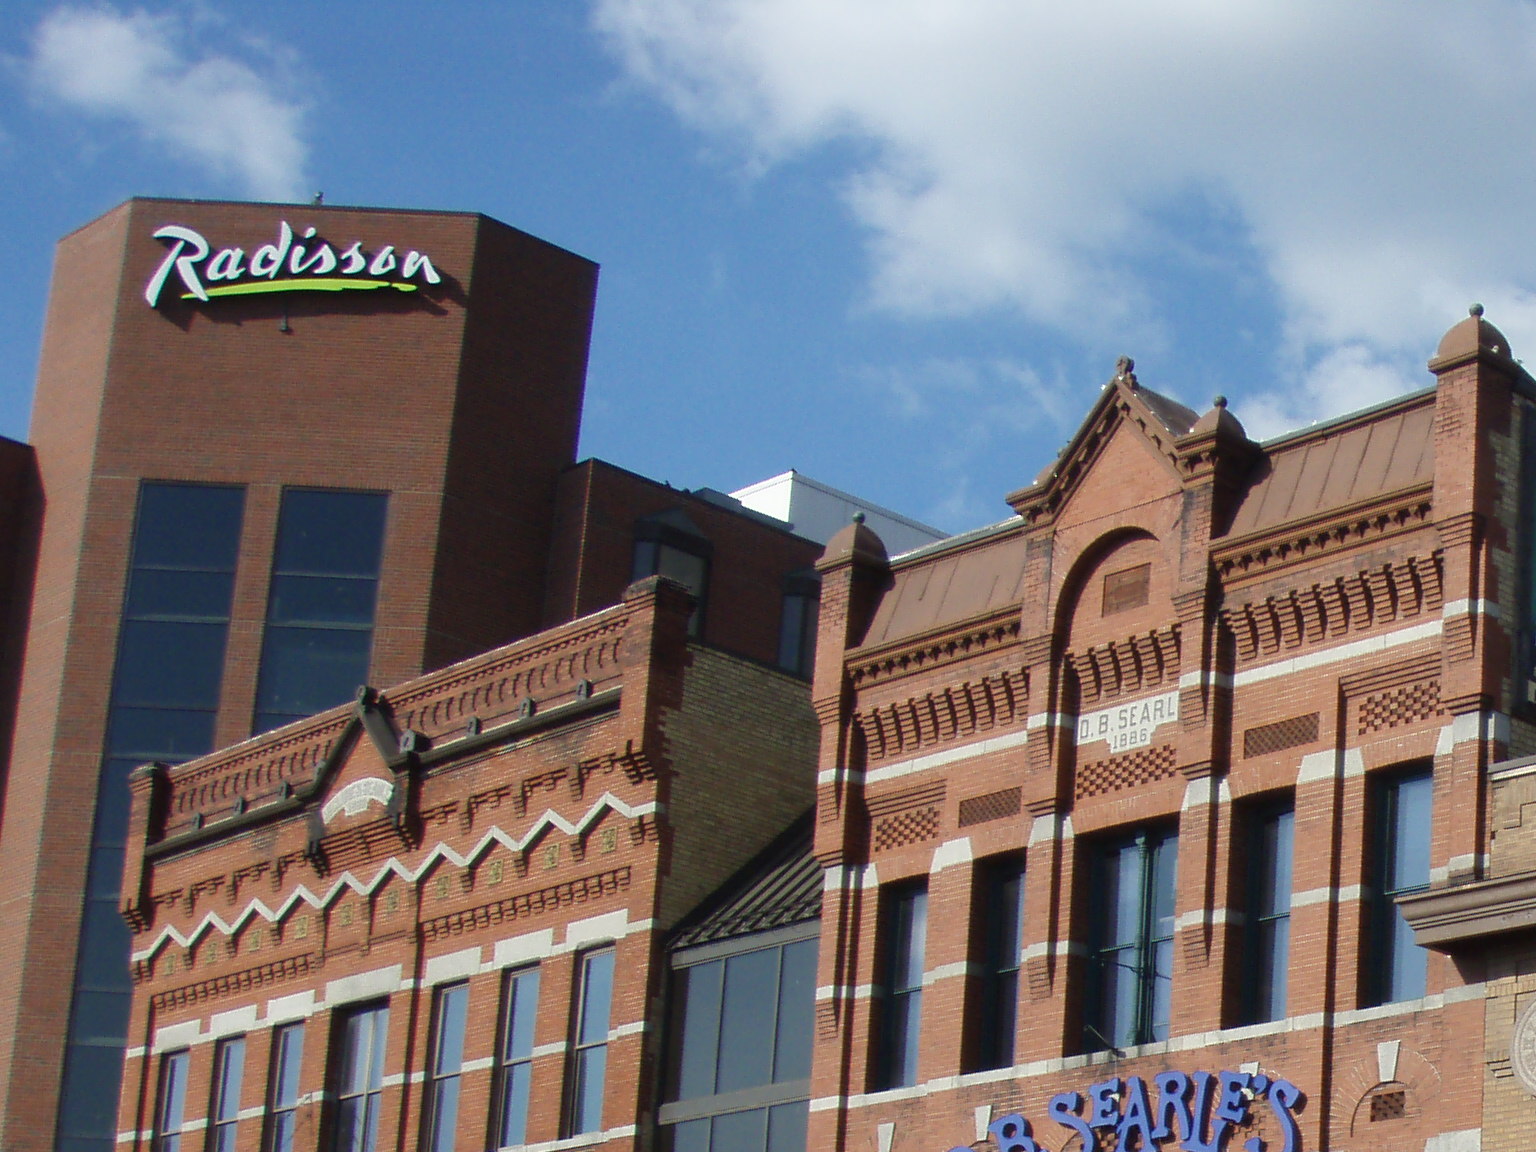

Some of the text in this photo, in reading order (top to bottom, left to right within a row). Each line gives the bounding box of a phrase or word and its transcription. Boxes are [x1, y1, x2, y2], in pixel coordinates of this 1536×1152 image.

[146, 220, 441, 307] Radisson
[1119, 697, 1175, 729] SEARL
[1113, 728, 1147, 749] 1886
